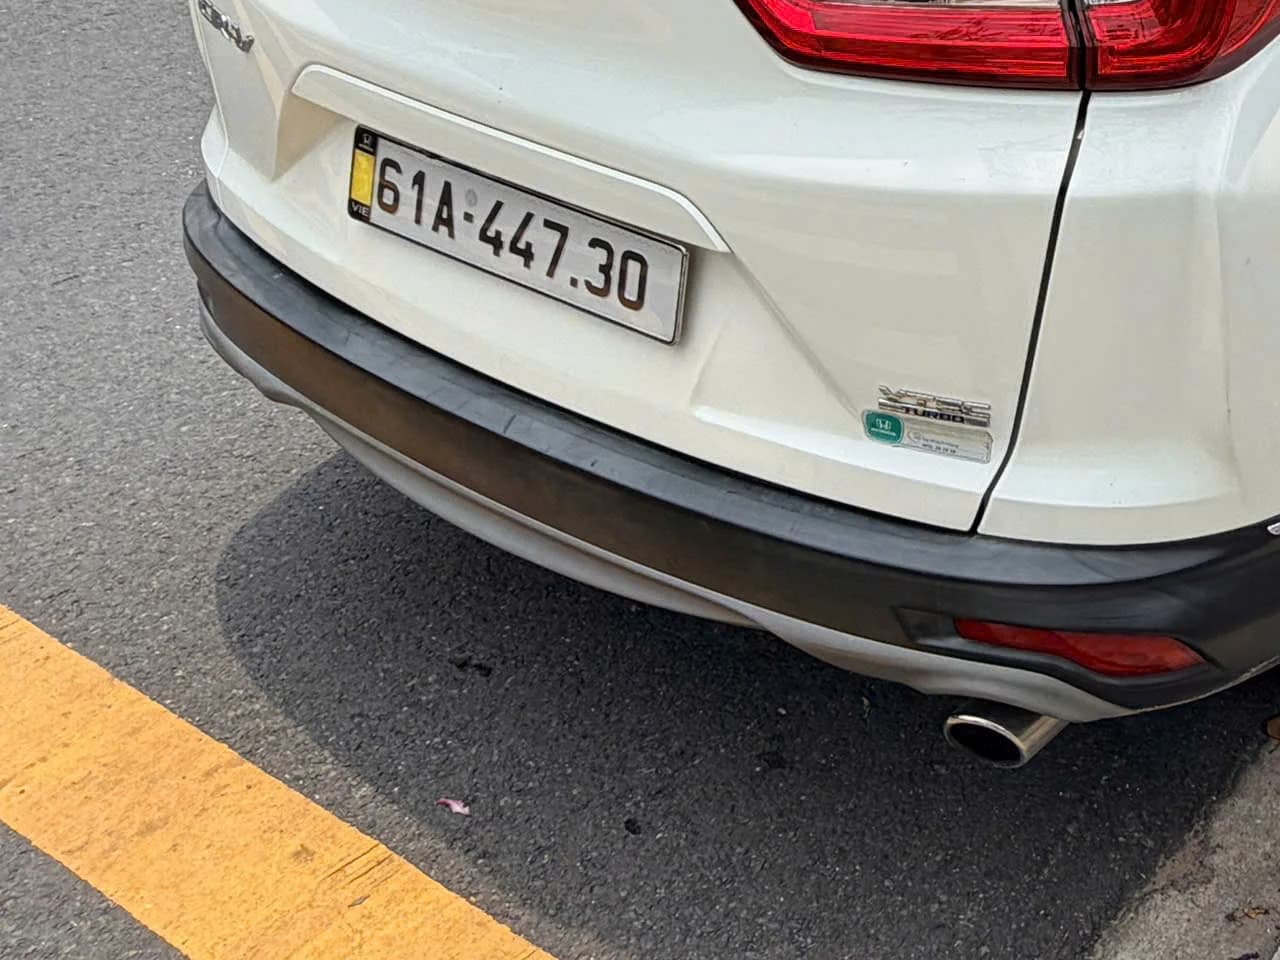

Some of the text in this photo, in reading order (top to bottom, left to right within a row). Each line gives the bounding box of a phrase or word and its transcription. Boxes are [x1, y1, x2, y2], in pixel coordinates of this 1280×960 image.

[351, 201, 370, 217] VIE
[376, 156, 649, 312] 61A-447.30
[903, 406, 965, 424] TURBO
